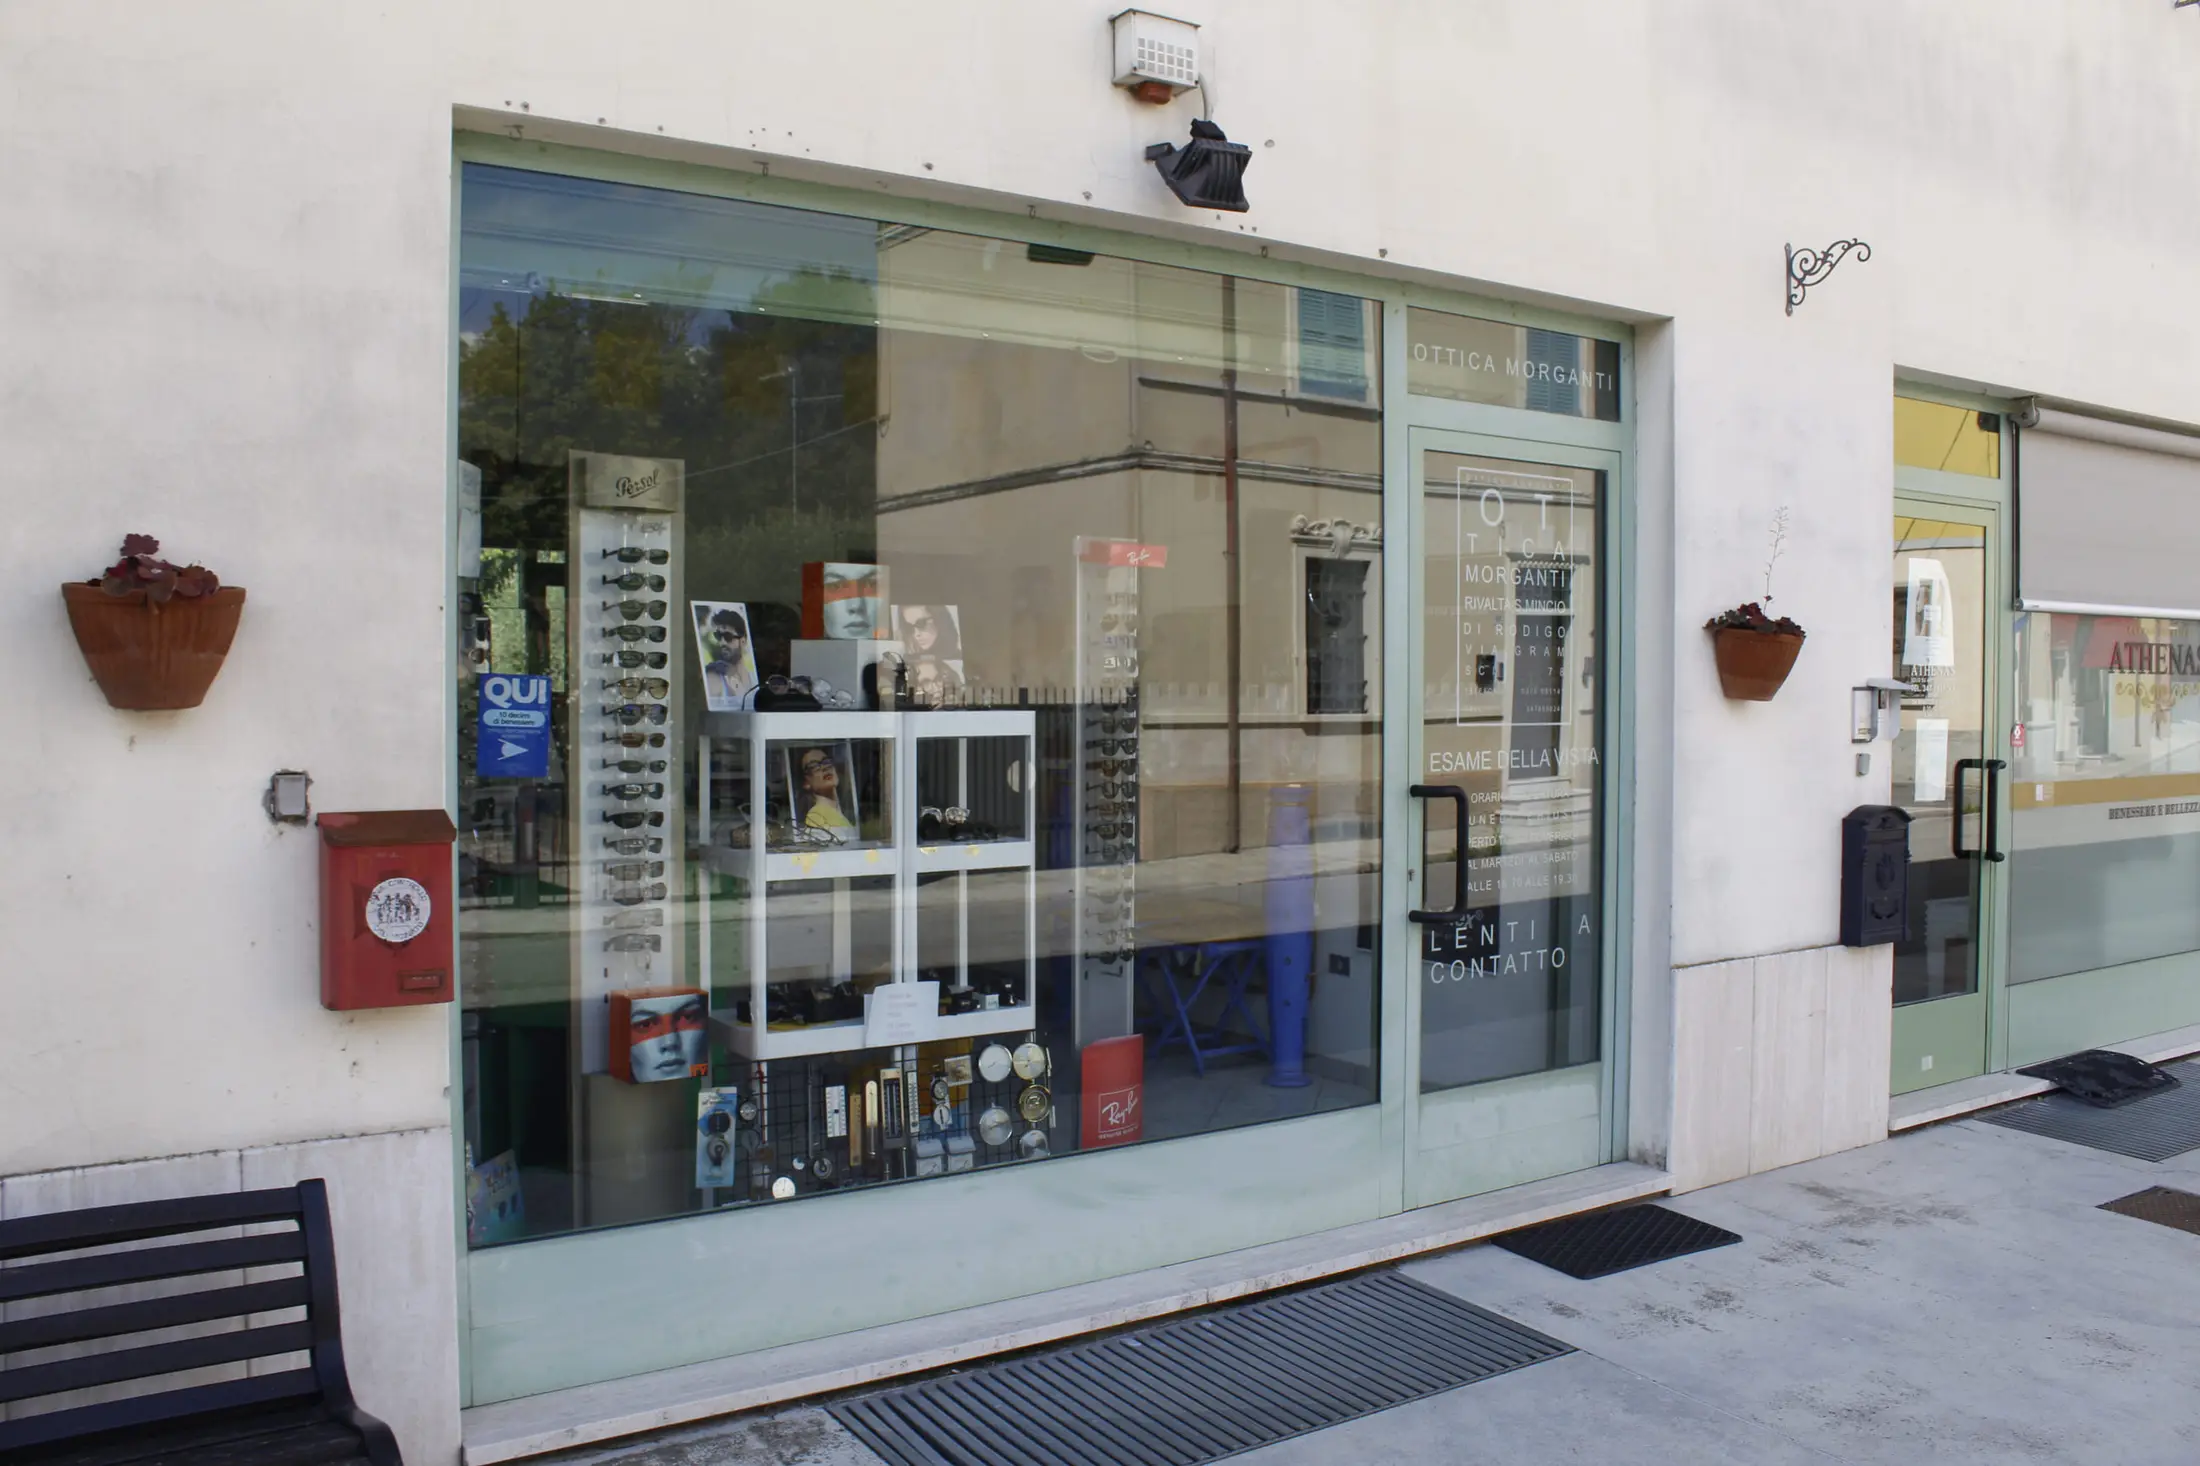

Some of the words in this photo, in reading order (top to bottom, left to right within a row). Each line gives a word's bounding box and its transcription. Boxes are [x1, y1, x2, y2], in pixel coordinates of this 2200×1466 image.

[1413, 343, 1496, 373] OTTICA
[1505, 357, 1613, 391] MORGANTI
[615, 468, 661, 498] Persol
[1465, 564, 1566, 588] MORGANTI
[1464, 595, 1510, 612] RIVALTA
[1463, 622, 1481, 635] DI
[1495, 624, 1566, 638] RODIGO
[1465, 643, 1497, 655] VIA
[484, 677, 547, 708] QUI
[1429, 751, 1492, 773] ESAME
[1498, 749, 1551, 769] DELLA
[1553, 747, 1599, 767] VISTA
[1470, 791, 1505, 804] ORARI
[2108, 805, 2156, 820] BENESSERE
[1543, 850, 1579, 864] SABATO
[1467, 880, 1492, 892] ALLE
[1430, 919, 1535, 952] LENTI
[1578, 914, 1591, 934] A
[1430, 947, 1565, 984] CONTATTO
